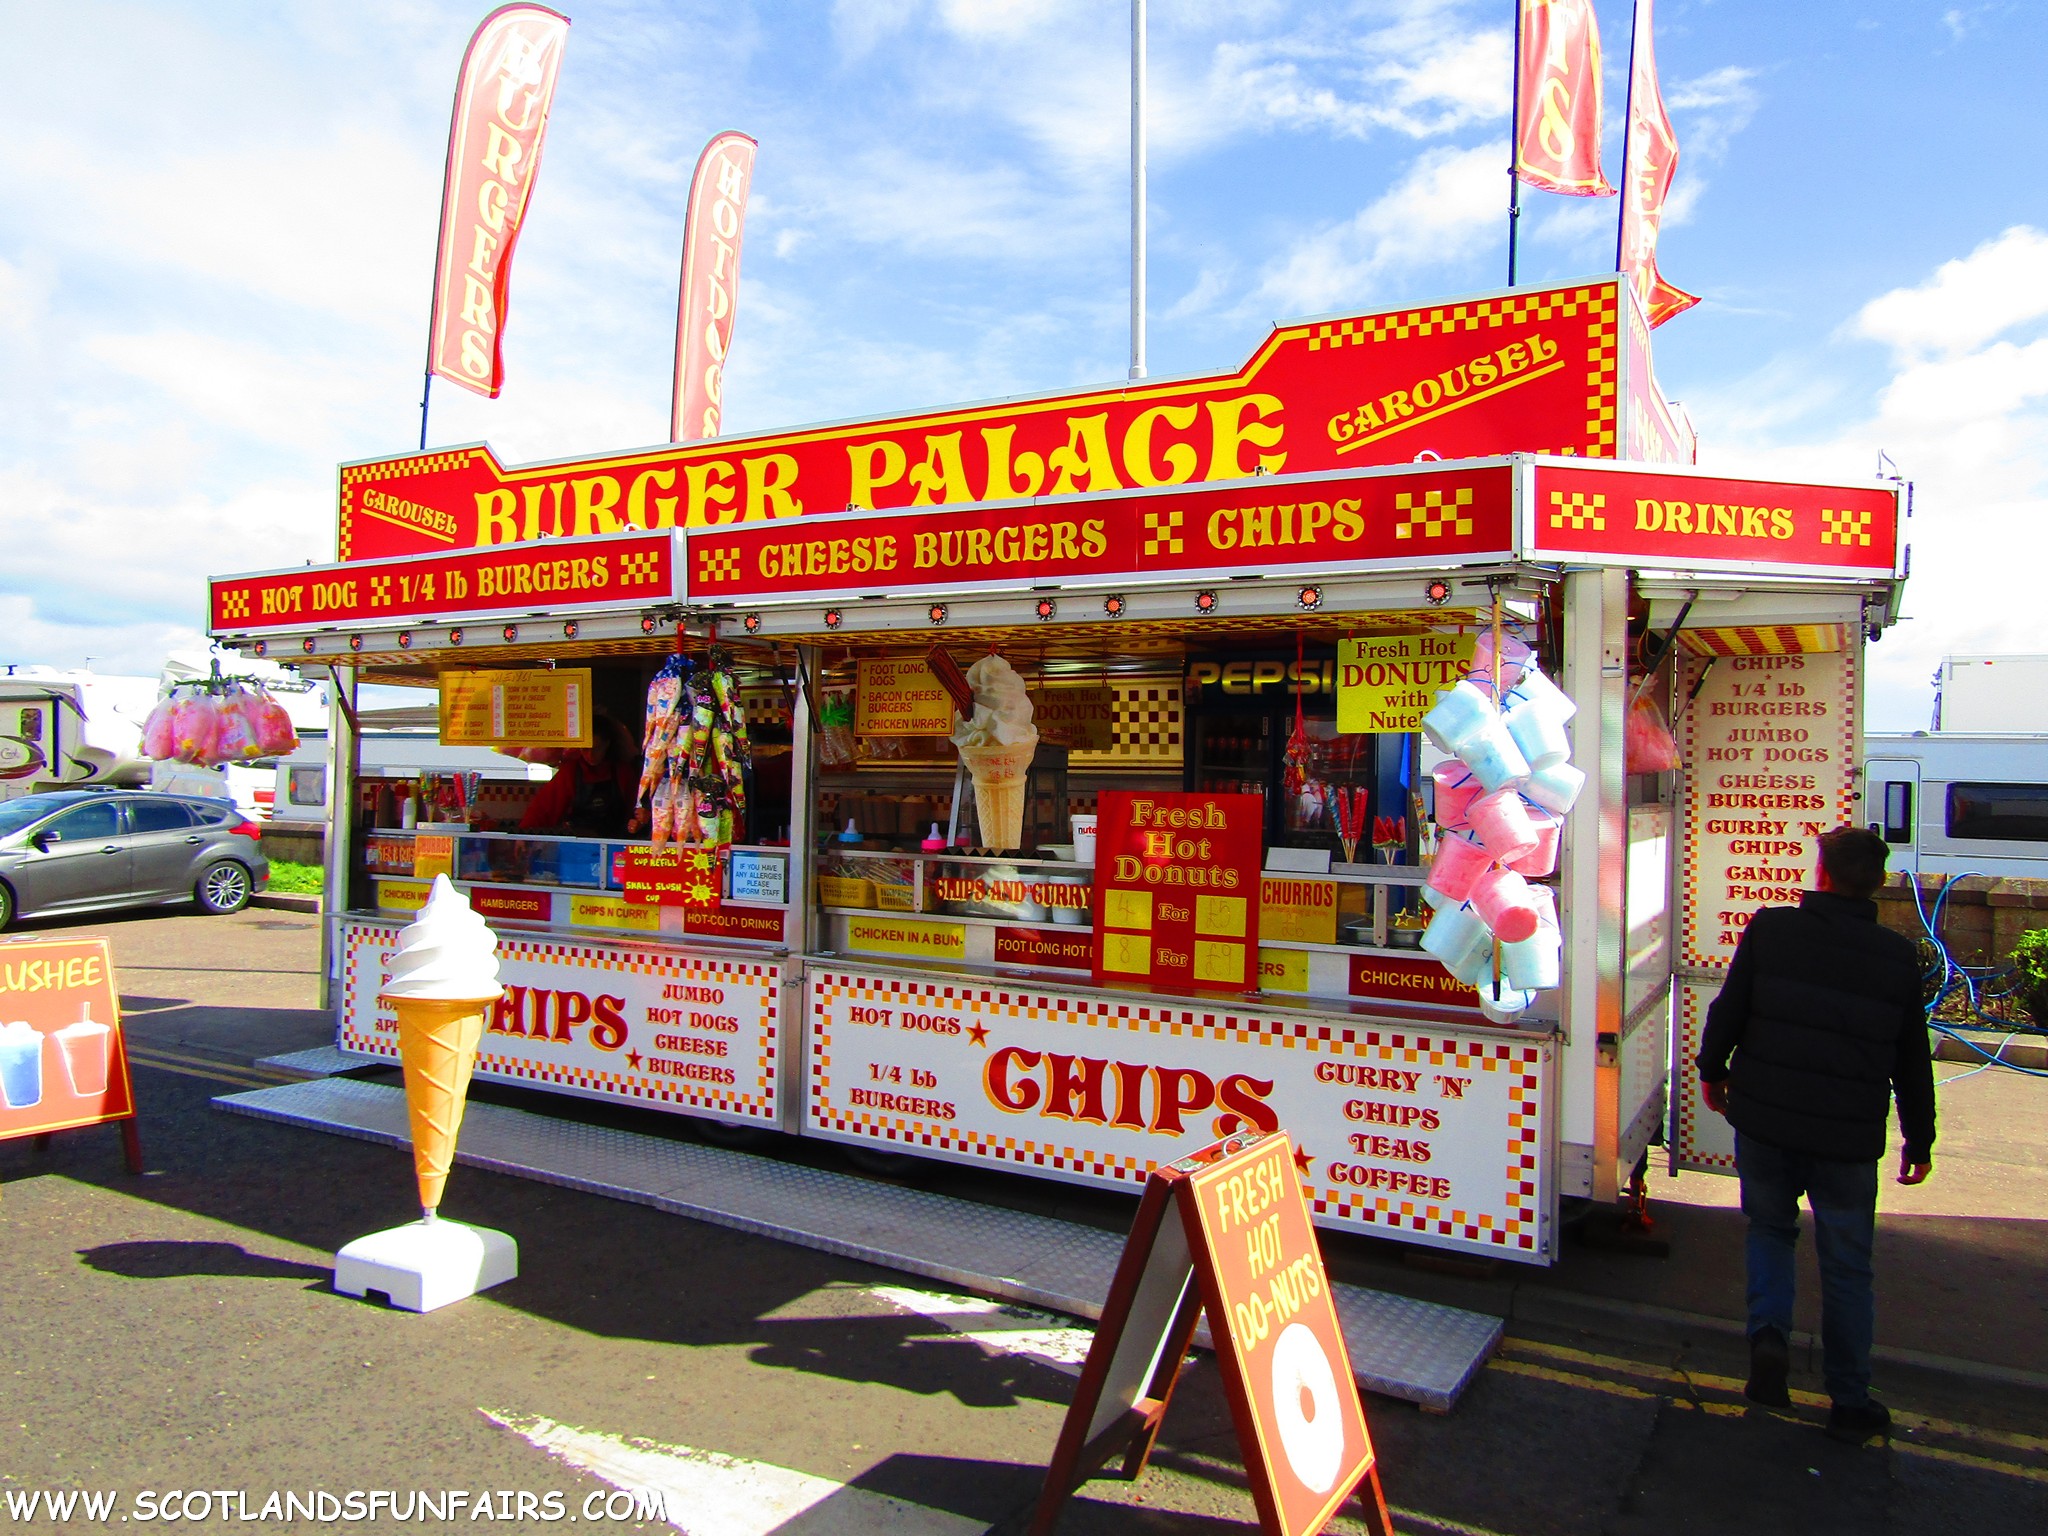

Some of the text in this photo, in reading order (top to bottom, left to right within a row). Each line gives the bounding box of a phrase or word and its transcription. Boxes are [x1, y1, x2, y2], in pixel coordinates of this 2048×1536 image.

[460, 29, 543, 379] BURGERS
[1327, 333, 1558, 443] CAROUSEL
[474, 393, 1288, 546] BURGER PALACE
[363, 488, 457, 535] CAROUSEL
[1634, 499, 1795, 540] DRINKS
[758, 498, 1366, 579] CHEESE BURGERS CHIPS
[261, 588, 304, 614] HOT
[313, 581, 358, 611] DOG
[400, 574, 435, 603] 1/4
[476, 556, 610, 596] BURGERS
[1356, 637, 1457, 659] Fresh Hot
[869, 664, 896, 675] FOOT
[897, 663, 925, 675] LONG
[1342, 659, 1471, 688] DONUTS
[1732, 655, 1805, 671] CHIPS
[869, 676, 896, 686] DOGS
[1188, 658, 1335, 695] PEPSI
[868, 690, 944, 702] BACON CHEESE
[1044, 689, 1102, 702] Fresh Hot
[1384, 690, 1429, 708] with
[1732, 683, 1767, 698] 1/4
[868, 702, 913, 714] BURGERS
[1036, 703, 1111, 720] DONUTS
[1711, 701, 1828, 717] BURGERS
[867, 718, 947, 729] CHICKEN WRAPS
[1369, 711, 1430, 729] Nutel
[1727, 728, 1809, 743] JUMBO
[1707, 747, 1829, 763] HOT DOGS
[1718, 774, 1816, 790] CHEESE
[1707, 793, 1826, 810] BURGERS
[1131, 799, 1227, 829] Fresh
[1077, 825, 1097, 834] nute
[1705, 820, 1789, 836] CURRY
[1143, 831, 1212, 861] Hot
[1728, 840, 1804, 857] CHIPS
[634, 858, 648, 866] CUP
[1114, 855, 1239, 889] Donuts
[749, 872, 783, 881] ALLERGIES
[1725, 866, 1807, 882] CANDY
[384, 888, 416, 900] CHICKEN
[626, 881, 682, 891] SMALL SLUSH
[761, 889, 781, 897] STAFF
[1032, 882, 1092, 910] CURRY
[1262, 880, 1334, 907] CHURROS
[1726, 885, 1803, 903] FLOSS
[480, 898, 539, 911] HAMBURGERS
[645, 894, 660, 903] CUP
[1117, 892, 1136, 922] 4
[1157, 903, 1190, 921] For
[579, 905, 649, 920] CHIPS N CURRY
[740, 917, 780, 932] DRINKS
[853, 926, 960, 947] CHICKEN IN A BUN
[998, 937, 1028, 952] FOOT
[1029, 941, 1061, 956] LONG
[1062, 944, 1088, 958] HOT
[1119, 936, 1131, 964] 8
[1156, 948, 1188, 967] For
[0, 956, 103, 994] USHEE
[1360, 969, 1435, 989] CHICKEN
[662, 984, 725, 1006] JUMBO
[485, 983, 629, 1052] HIPS
[646, 1007, 740, 1034] HOT DOGS
[849, 1006, 962, 1036] HOT DOGS
[655, 1033, 729, 1058] CHEESE
[647, 1057, 736, 1086] BURGERS
[868, 1062, 903, 1083] 1/4
[1313, 1061, 1472, 1100] CURRY 'N'
[982, 1045, 1280, 1137] CHIPS
[849, 1087, 957, 1121] BURGERS
[1342, 1099, 1441, 1132] CHIPS
[1348, 1132, 1432, 1164] TEAS
[1327, 1161, 1451, 1200] COFFEE
[1215, 1153, 1285, 1234] FRESH
[1245, 1213, 1283, 1279] HOT
[1235, 1253, 1321, 1352] DO-NUTS
